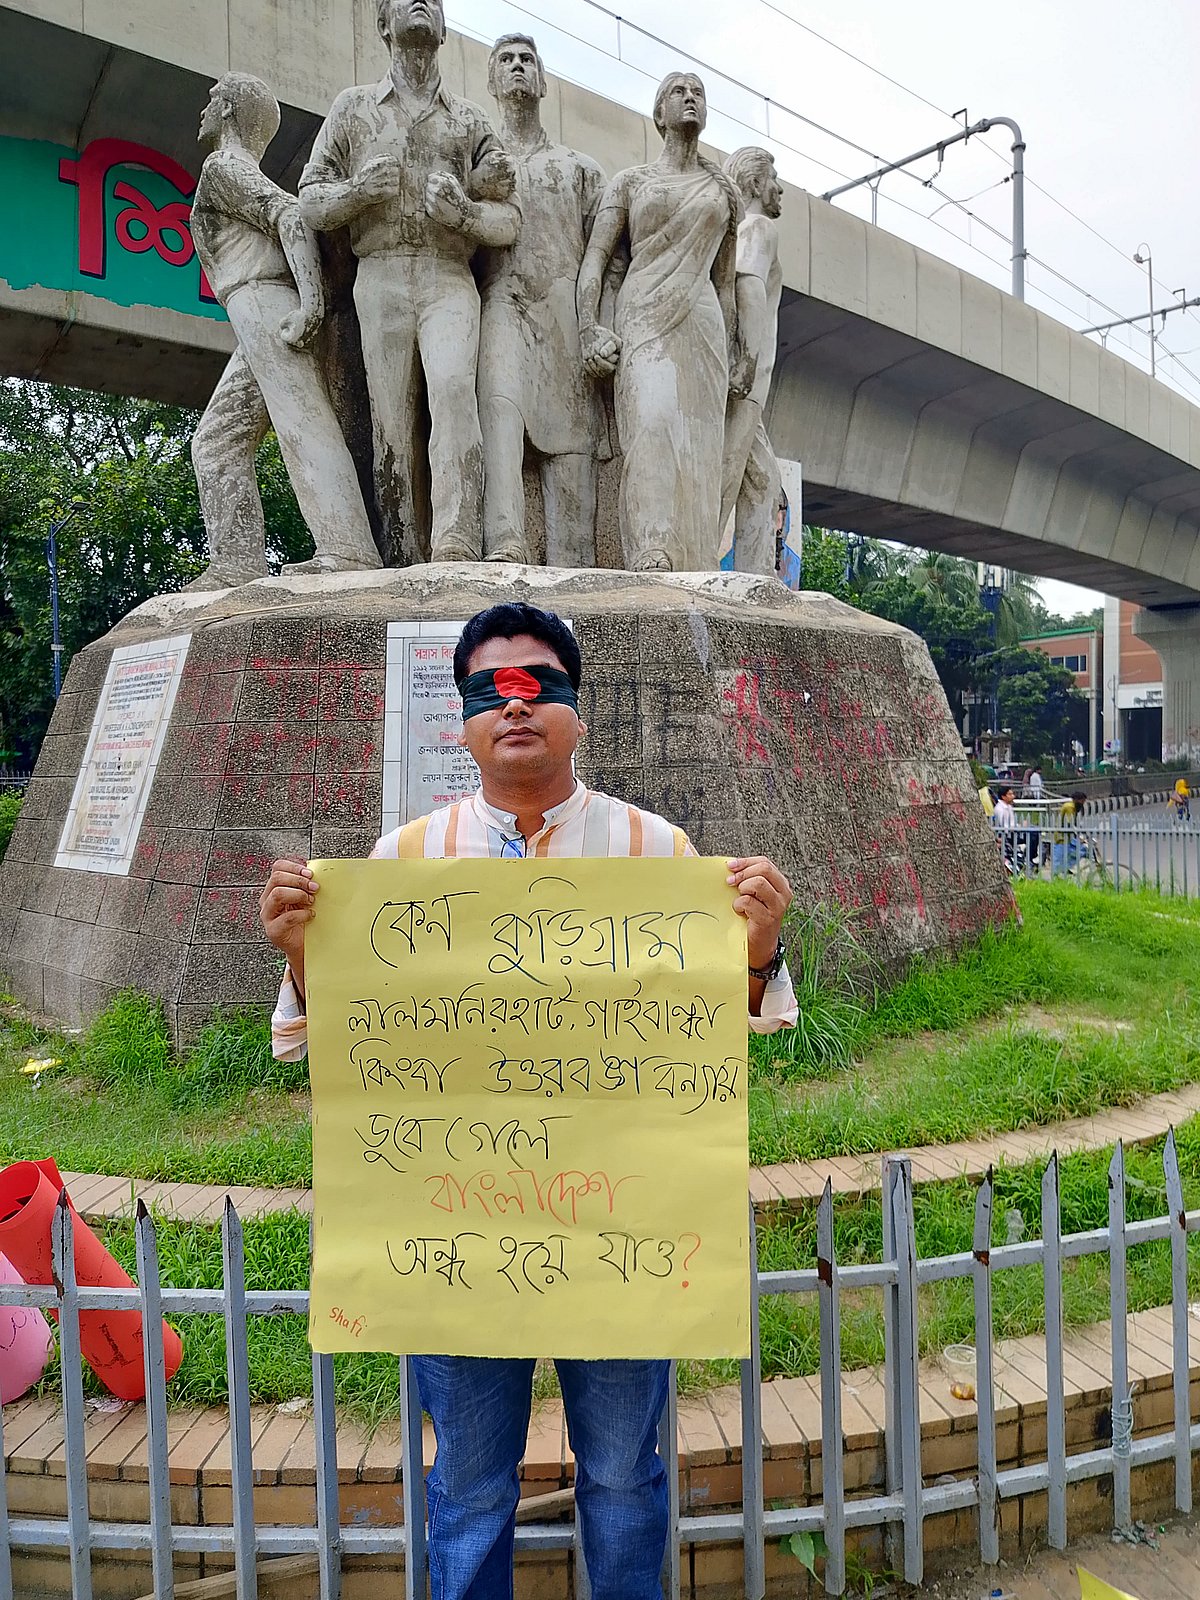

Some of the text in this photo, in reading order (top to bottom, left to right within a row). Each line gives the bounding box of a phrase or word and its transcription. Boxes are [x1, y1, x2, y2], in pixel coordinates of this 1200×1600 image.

[423, 713, 457, 723] অধ্যাপক
[371, 876, 719, 986] কেন কুড়িগ্রাম
[349, 1037, 462, 1093] কিংবা
[650, 1056, 748, 1116] বন্যায়
[354, 1114, 574, 1173] ডুবে গেলে
[424, 1169, 645, 1225] বাংলাদেশ
[386, 1232, 487, 1290] অন্ধ
[497, 1234, 572, 1295] হয়ে
[328, 1306, 368, 1338] Shafi
